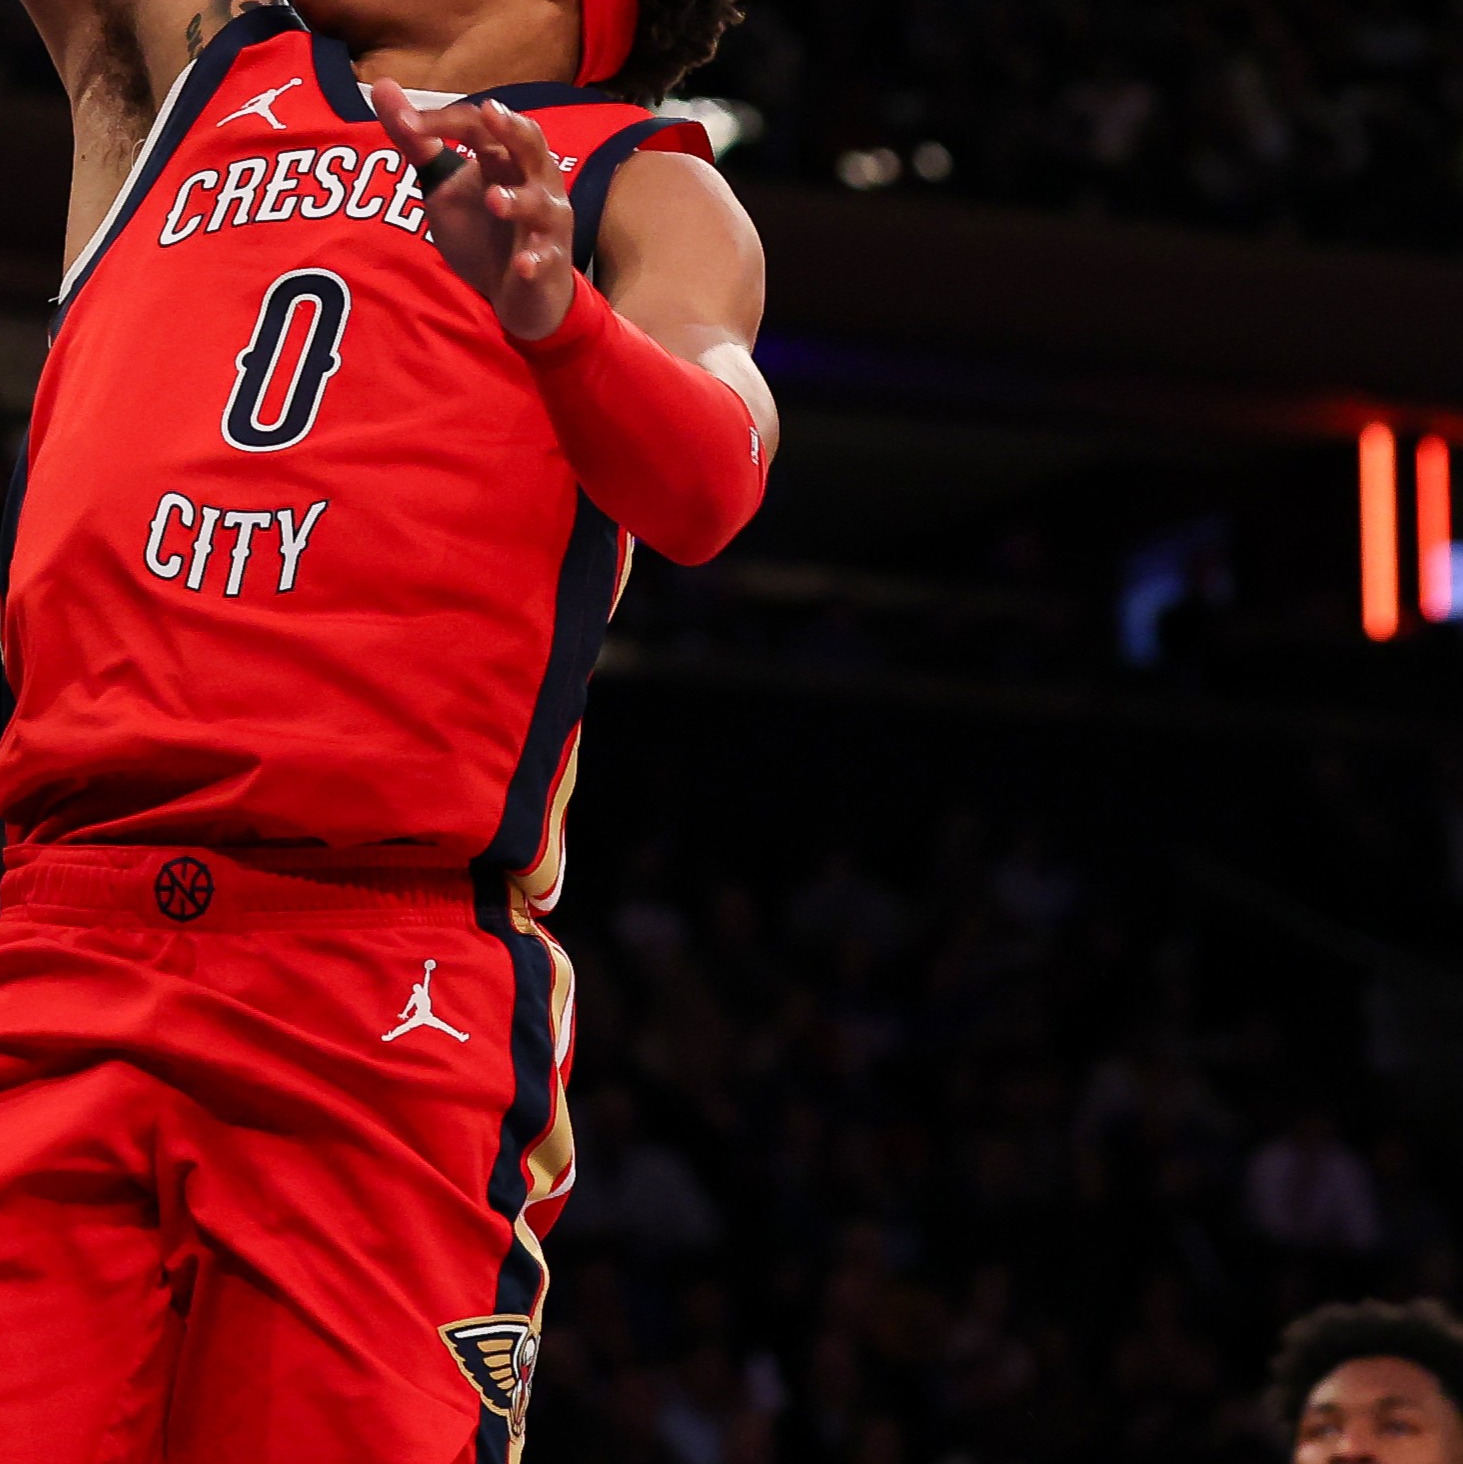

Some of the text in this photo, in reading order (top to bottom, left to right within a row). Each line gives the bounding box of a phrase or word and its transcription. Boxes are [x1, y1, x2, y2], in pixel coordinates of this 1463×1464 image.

[158, 144, 435, 247] CRESCE
[221, 267, 351, 453] 0
[144, 490, 329, 597] CITY
